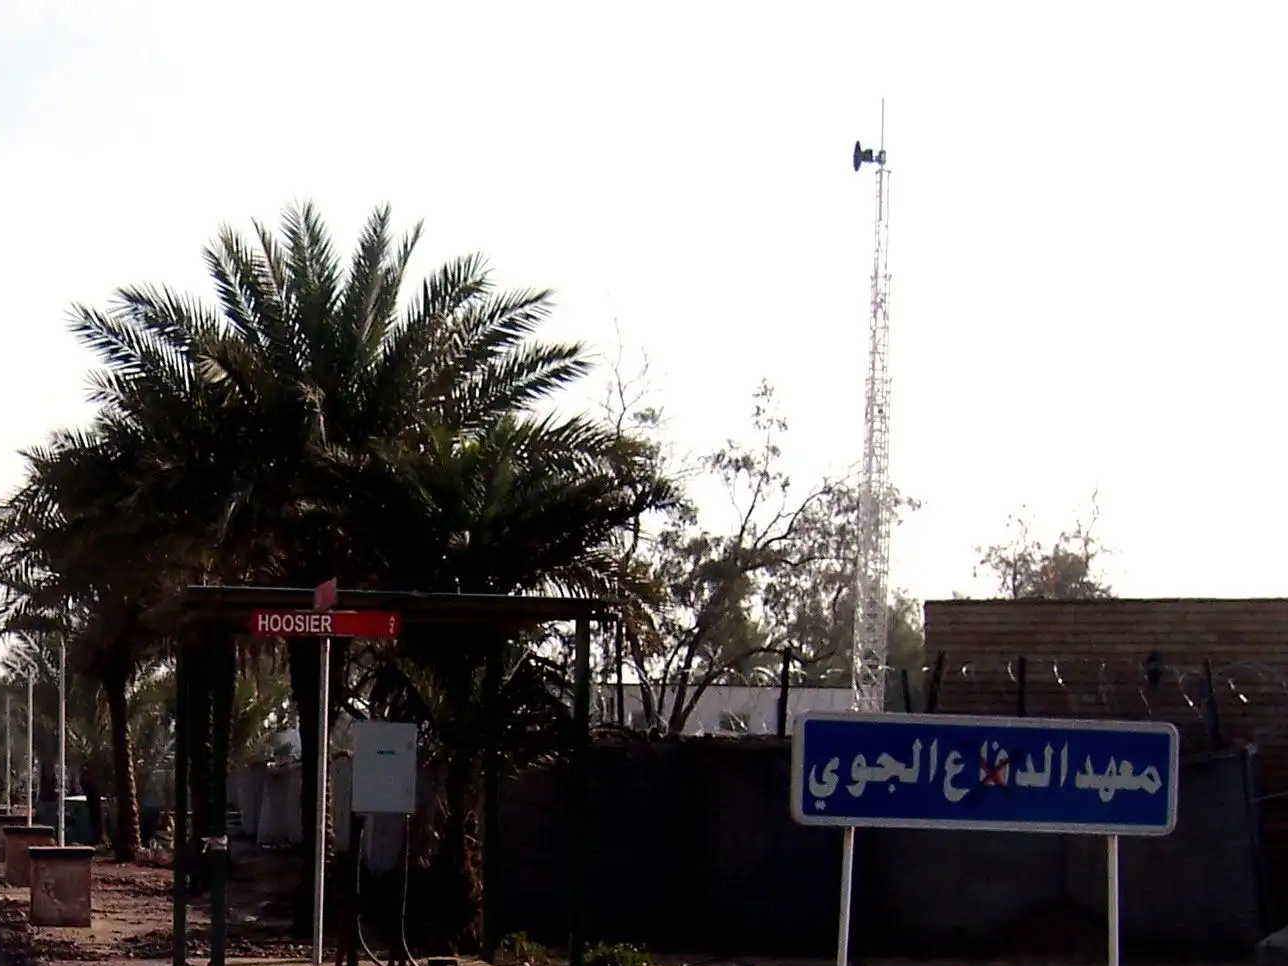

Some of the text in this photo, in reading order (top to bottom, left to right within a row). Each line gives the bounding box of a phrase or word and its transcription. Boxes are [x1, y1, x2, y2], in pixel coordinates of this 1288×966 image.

[258, 613, 332, 632] HOOSIER
[807, 737, 1162, 811] معهد الدفاع الجوي
